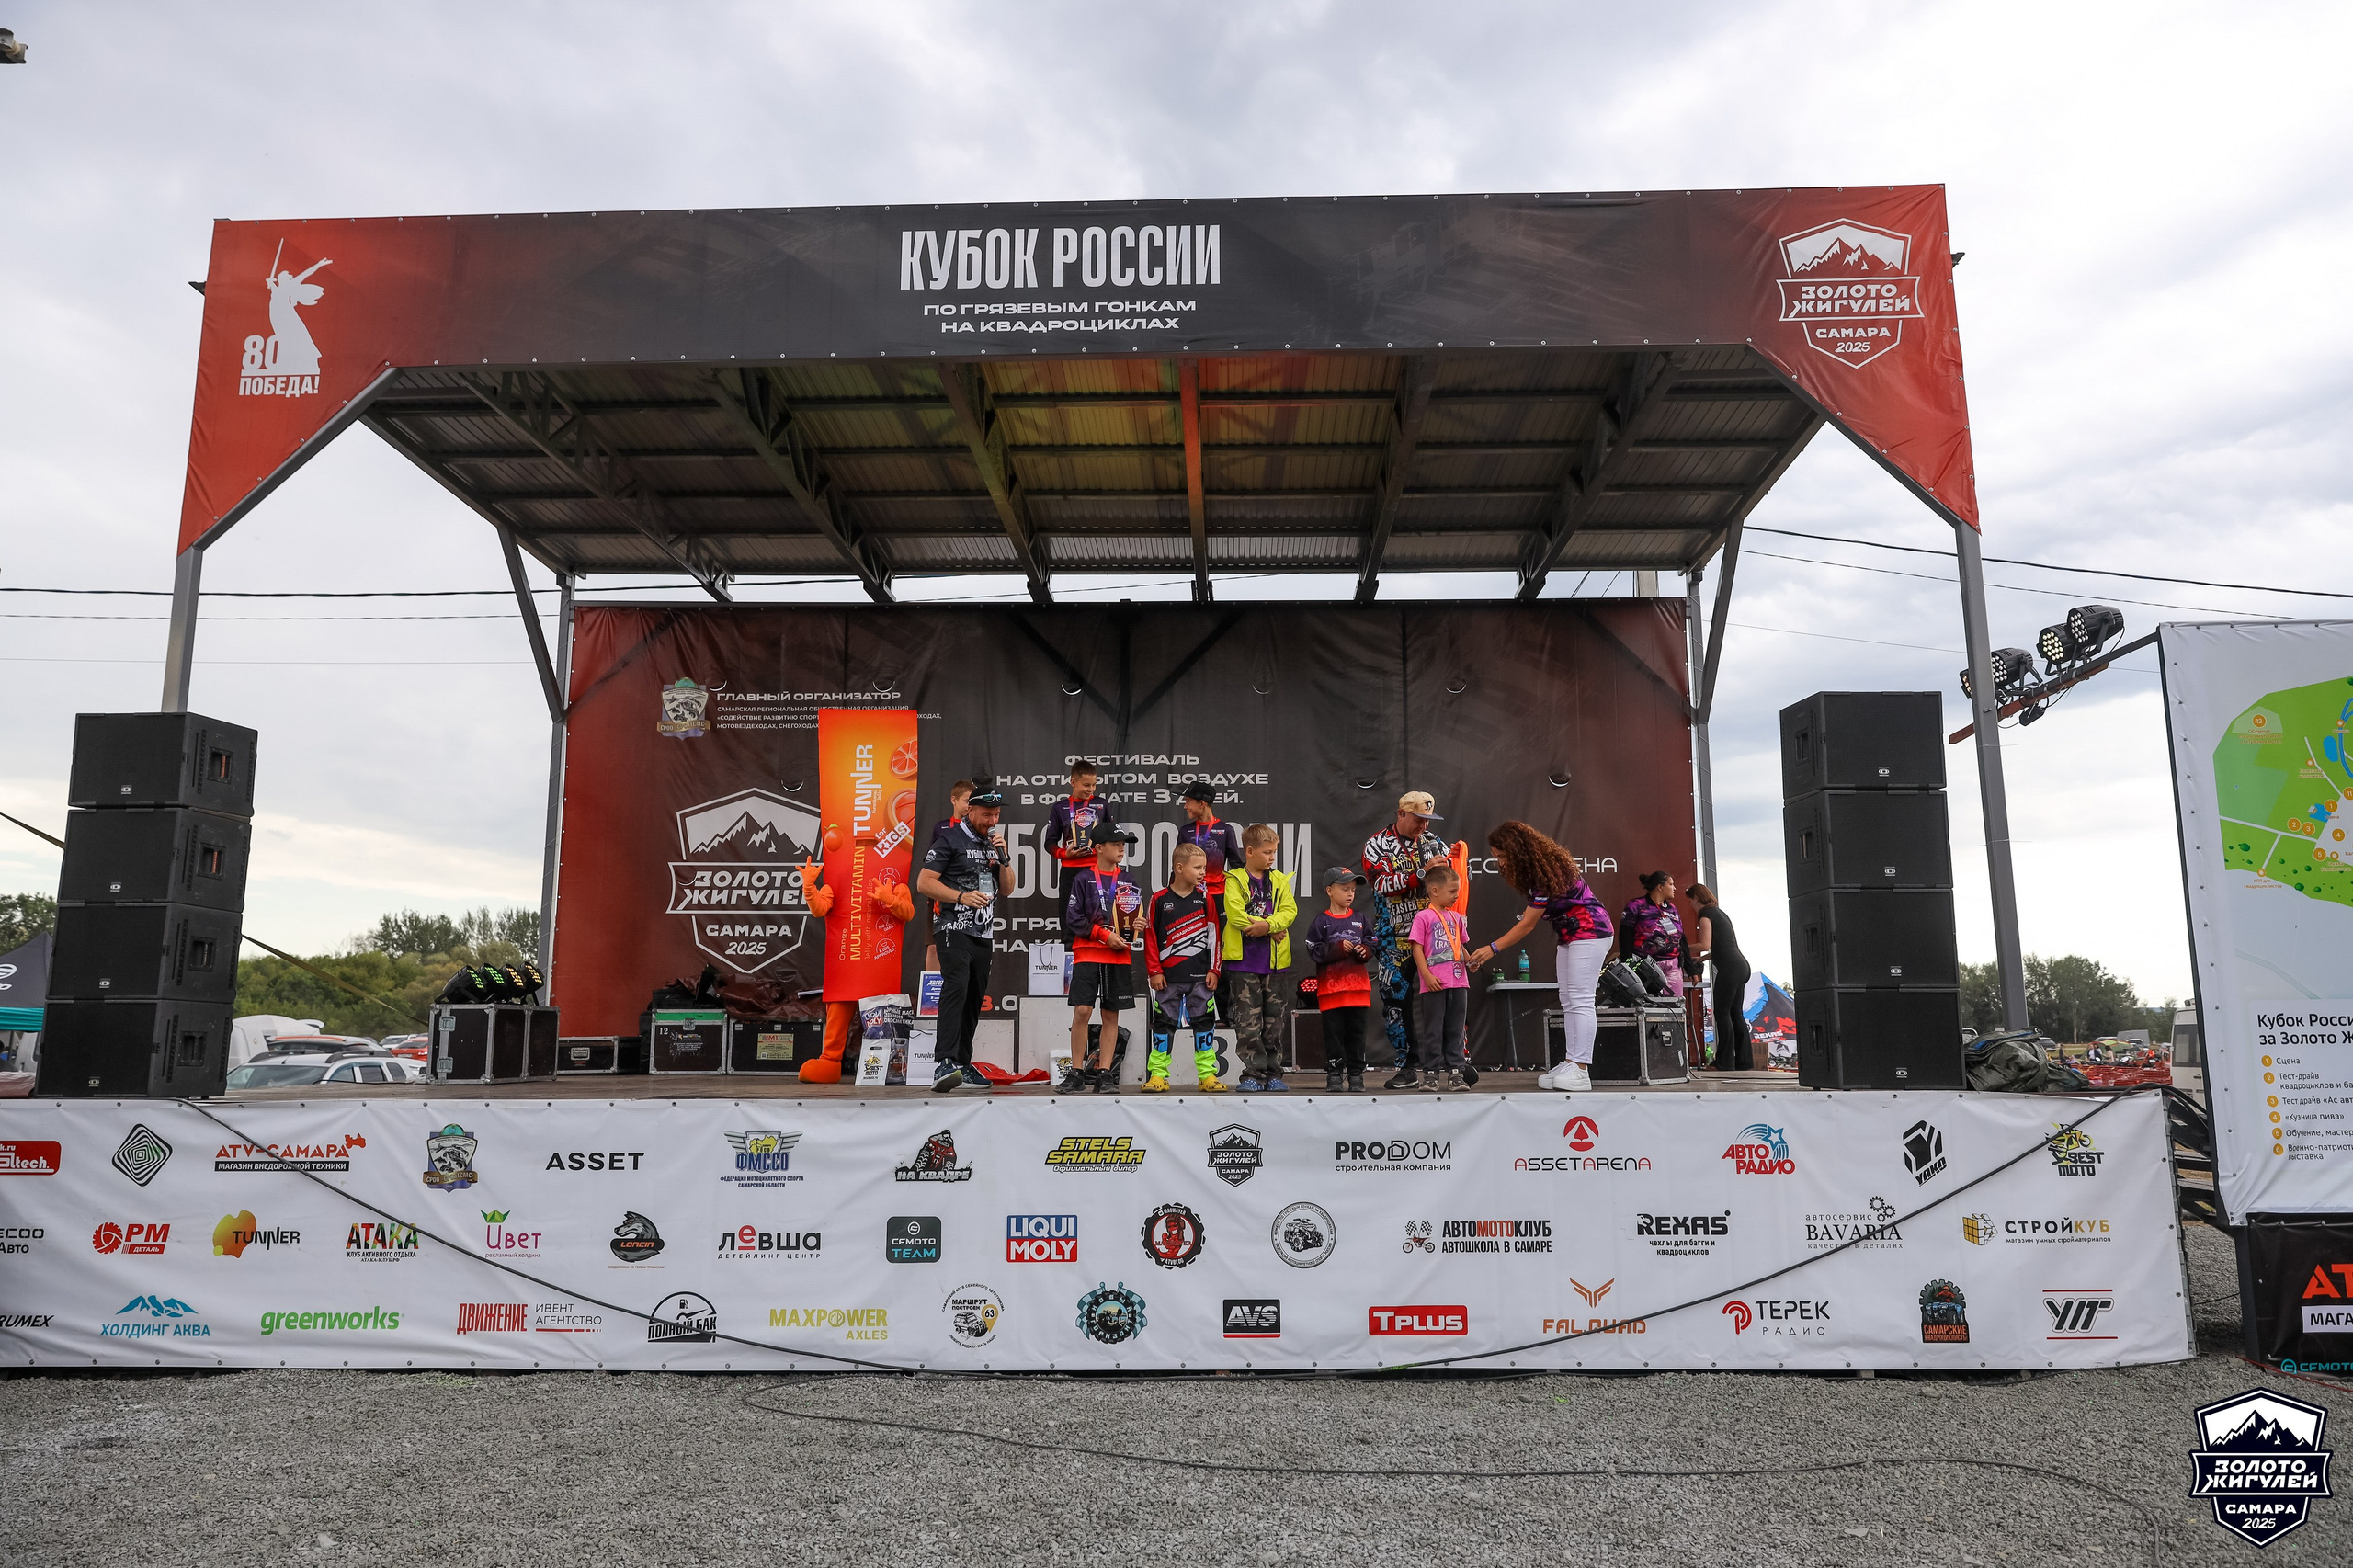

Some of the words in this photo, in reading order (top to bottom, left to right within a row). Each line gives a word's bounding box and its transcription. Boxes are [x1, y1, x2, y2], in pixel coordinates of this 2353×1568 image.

[901, 228, 1039, 290] КУБОК
[1053, 224, 1220, 287] РОССИИ
[1801, 284, 1897, 299] ЗОЛОТО
[924, 304, 956, 315] ПО
[961, 302, 1088, 315] ГРЯЗЕВЫМ
[1095, 300, 1196, 312] ГОНКАМ
[1789, 295, 1910, 318] ЖИГУЛЕЙ
[941, 322, 974, 333] НА
[981, 318, 1179, 333] КВАДРОЦИКЛАХ
[1815, 327, 1891, 338] САМАРА
[242, 335, 278, 369] 80
[1835, 342, 1870, 353] 2025
[239, 376, 320, 398] ПОБЕДА!
[717, 691, 791, 701] ГЛАВНЫЙ
[793, 692, 901, 701] ОРГАНИЗАТОР
[1064, 754, 1200, 766] ФЕСТИВАЛЬ
[995, 775, 1029, 786] НА
[1167, 773, 1269, 787] ВОЗДУХЕ
[850, 744, 881, 836] TUNNER
[1020, 794, 1035, 805] В
[1154, 788, 1172, 804] 3
[694, 871, 804, 888] ЗОЛОТО
[849, 846, 866, 960] MULTIVITAMIN
[705, 925, 792, 937] САМАРА
[724, 942, 767, 955] 2025
[839, 928, 847, 960] Orange
[2257, 1013, 2304, 1029] Кубок
[2259, 1034, 2276, 1045] за
[2281, 1032, 2337, 1045] Золото
[2276, 1057, 2301, 1065] Сцена
[2279, 1073, 2319, 1081] Тест-драйв
[2280, 1083, 2335, 1091] квадроциклов
[2300, 1096, 2321, 1106] драйв
[2285, 1113, 2317, 1121] «Кузница
[2286, 1129, 2324, 1138] Обучение,
[1059, 1138, 1132, 1150] STELS
[1336, 1141, 1451, 1161] PRODOM
[1046, 1151, 1145, 1164] SAMARA
[1722, 1144, 1769, 1159] АВТО
[2068, 1152, 2104, 1164] BEST
[2289, 1153, 2324, 1161] выставка
[546, 1153, 644, 1170] ASSET
[736, 1153, 789, 1171] ФМССО
[1212, 1156, 1257, 1165] ЖИГУЛЕЙ
[1514, 1158, 1652, 1171] ASSETARENA
[1736, 1159, 1795, 1175] РАДИО
[897, 1171, 915, 1180] НА
[919, 1170, 970, 1181] КВАДРЕ
[1113, 1165, 1138, 1173] дилер
[1336, 1165, 1401, 1173] строительная
[1404, 1164, 1450, 1172] компания
[2058, 1165, 2096, 1176] MOTO
[1805, 1214, 1872, 1222] автосервис
[2005, 1217, 2110, 1233] СТРОЙКУБ
[1011, 1217, 1074, 1239] LIQUI
[1442, 1221, 1552, 1238] АВТОМОТОКЛУБ
[1805, 1224, 1903, 1240] BAVARIA
[232, 1227, 301, 1250] TUNNER
[346, 1223, 419, 1249] АТАКА
[486, 1224, 542, 1249] Цвет
[718, 1225, 822, 1251] левша
[892, 1237, 936, 1245] CFMOTO
[892, 1248, 936, 1258] TEAM
[1010, 1240, 1076, 1260] MOLY
[1442, 1242, 1500, 1253] АВТОШКОЛА
[1504, 1242, 1510, 1252] В
[1515, 1241, 1552, 1253] САМАРЕ
[1656, 1249, 1710, 1257] квадроциклов
[536, 1303, 574, 1312] ИВЕНТ
[984, 1309, 995, 1317] 63
[1756, 1301, 1831, 1320] ТЕРЕК
[261, 1306, 399, 1335] greenworks
[457, 1303, 529, 1335] ДВИЖЕНИЕ
[536, 1316, 602, 1325] АГЕНТСТВО
[770, 1308, 888, 1327] MAXPOWER
[1226, 1305, 1278, 1327] AVS
[1373, 1312, 1463, 1331] TPLUS
[696, 1316, 717, 1331] БАК
[1762, 1326, 1825, 1335] РАДИО
[1924, 1324, 1967, 1335] САМАРСКИЕ
[100, 1324, 170, 1338] ХОЛДИНГ
[173, 1324, 210, 1336] АКВА
[846, 1330, 888, 1340] AXLES
